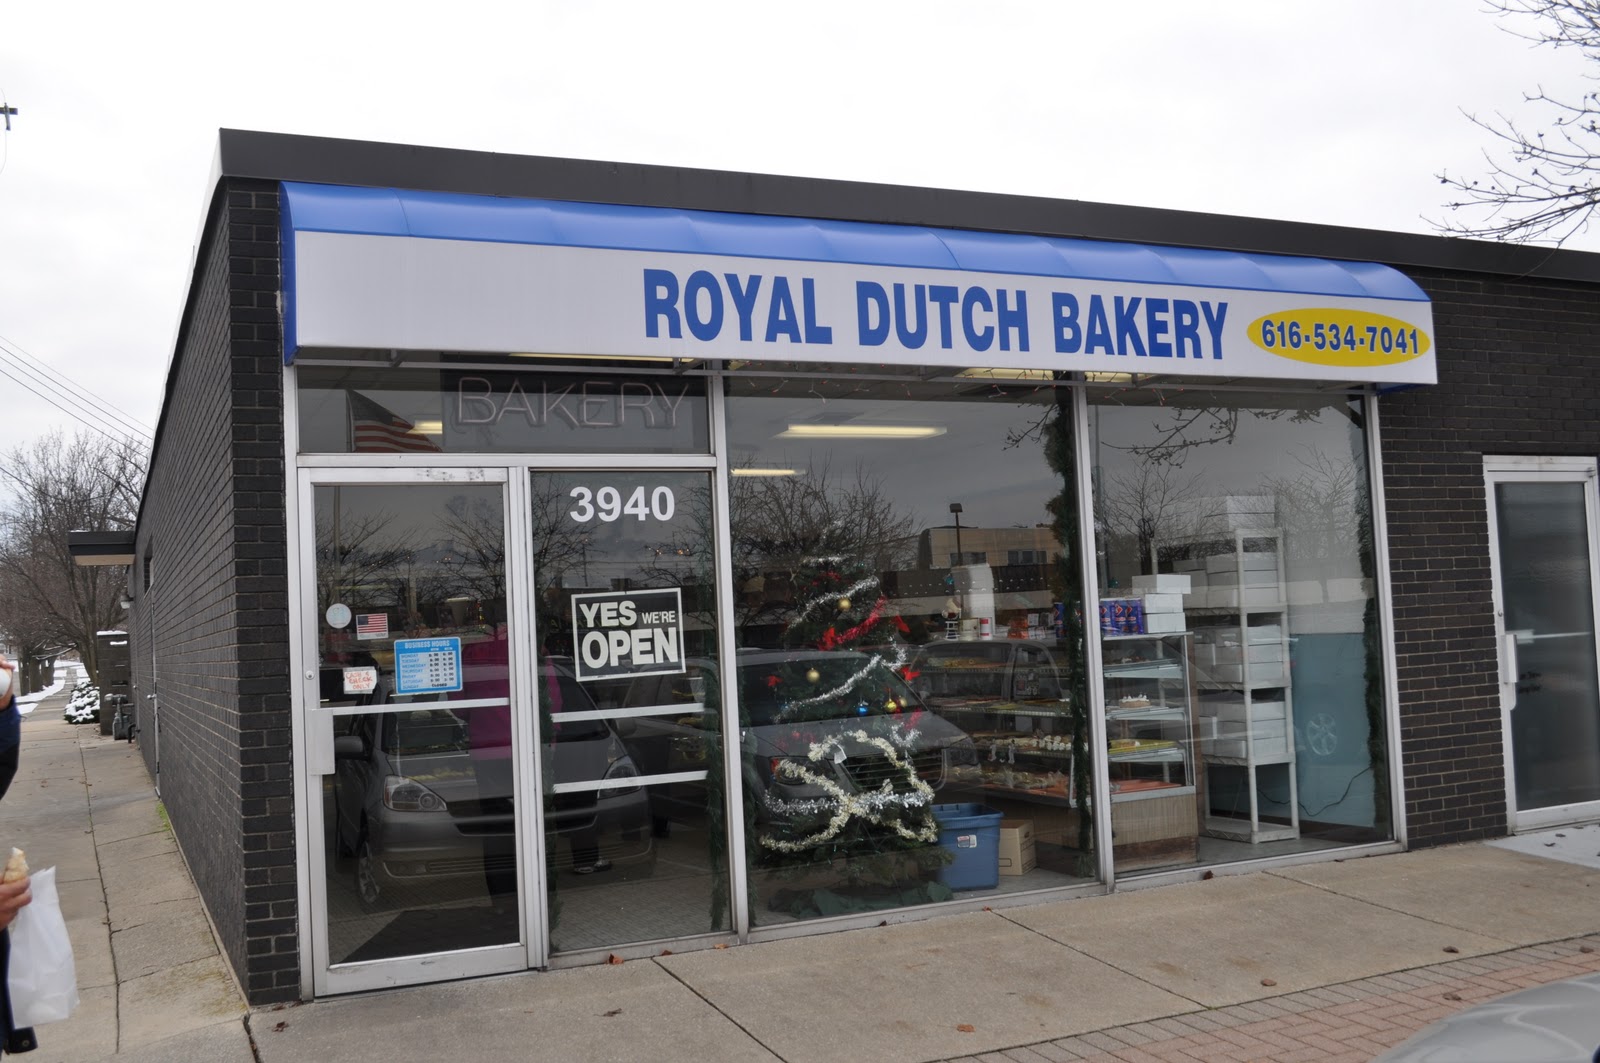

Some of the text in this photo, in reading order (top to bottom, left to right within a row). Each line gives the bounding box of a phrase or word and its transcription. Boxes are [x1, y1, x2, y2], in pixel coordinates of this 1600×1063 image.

[643, 268, 1229, 360] ROYAL DUTCH BAKERY
[1260, 319, 1420, 355] 616-534-7041
[457, 376, 690, 428] BAKERY
[569, 485, 676, 523] 3940
[578, 600, 677, 628] YES WE'RE
[404, 641, 431, 649] BUSINESS
[581, 627, 680, 669] OPEN
